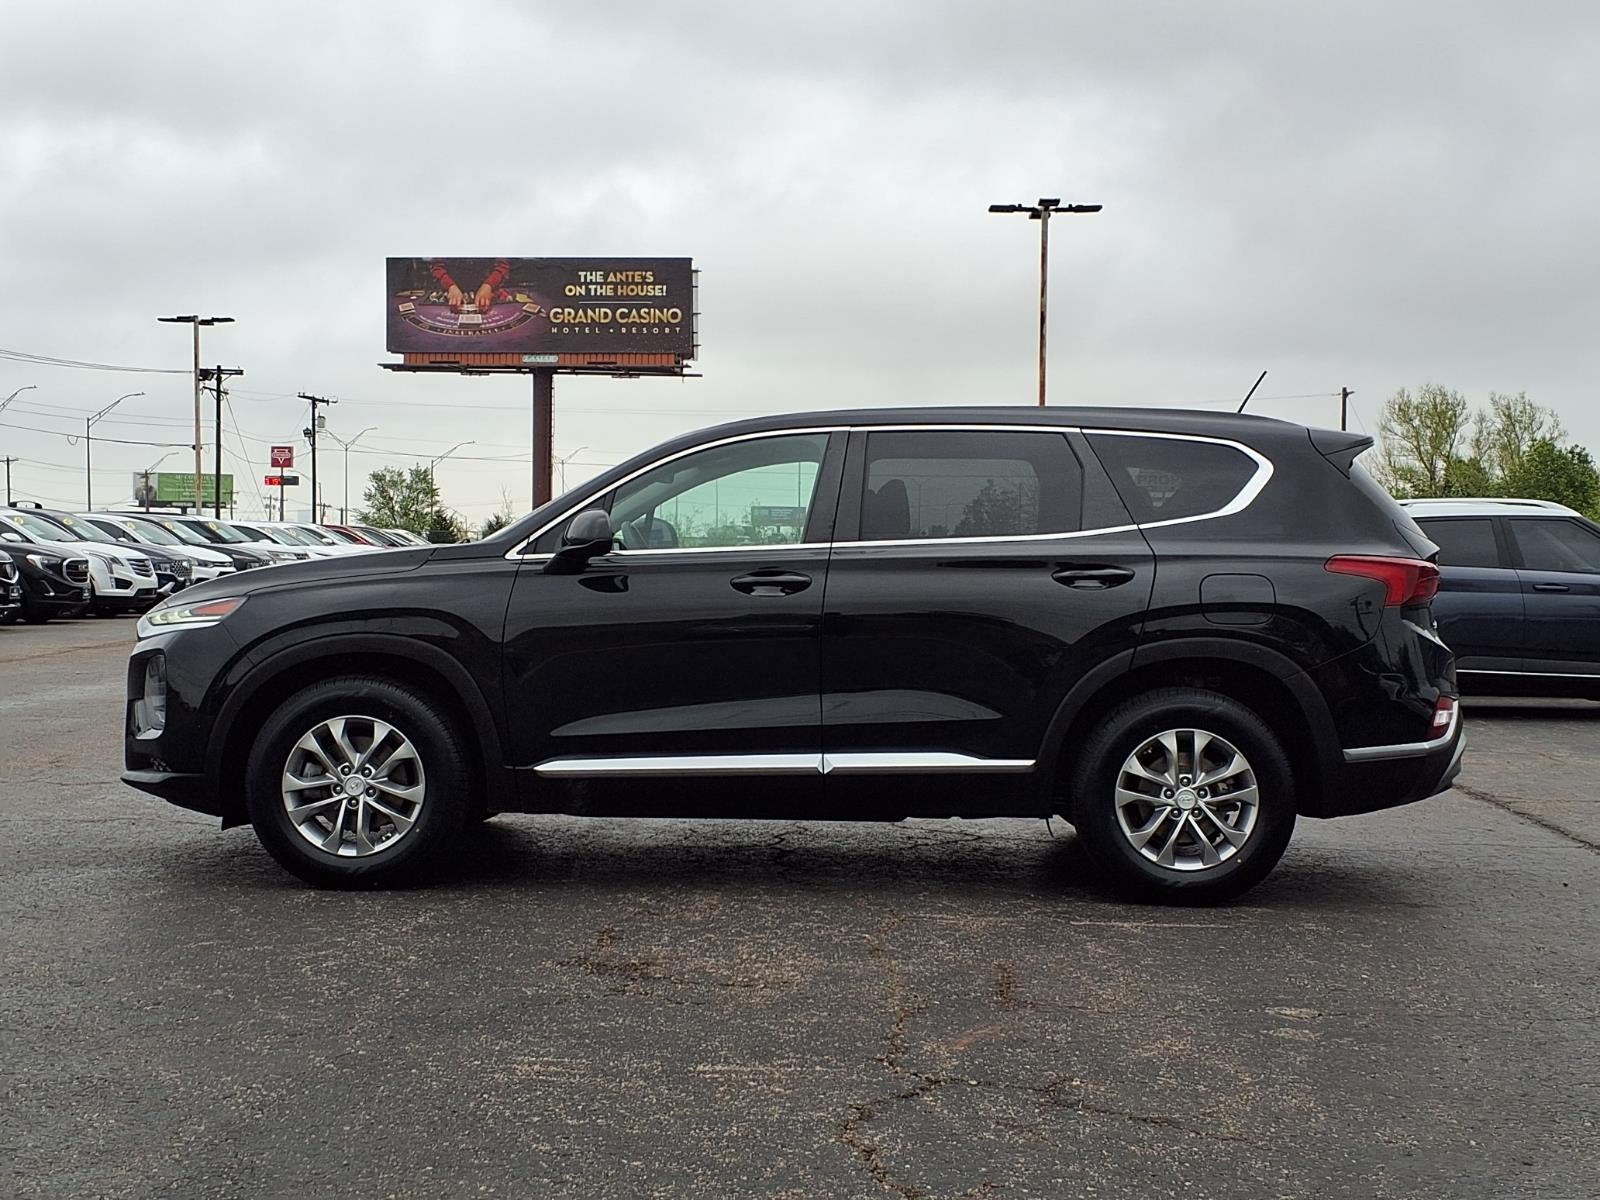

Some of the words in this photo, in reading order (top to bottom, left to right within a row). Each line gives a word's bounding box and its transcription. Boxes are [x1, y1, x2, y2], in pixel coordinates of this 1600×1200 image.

[578, 271, 604, 283] THE
[606, 271, 654, 283] ANTE'S
[564, 285, 586, 296] ON
[588, 285, 615, 296] THE
[617, 285, 667, 296] HOUSE!
[549, 307, 613, 324] GRAND
[615, 307, 682, 324] CASINO
